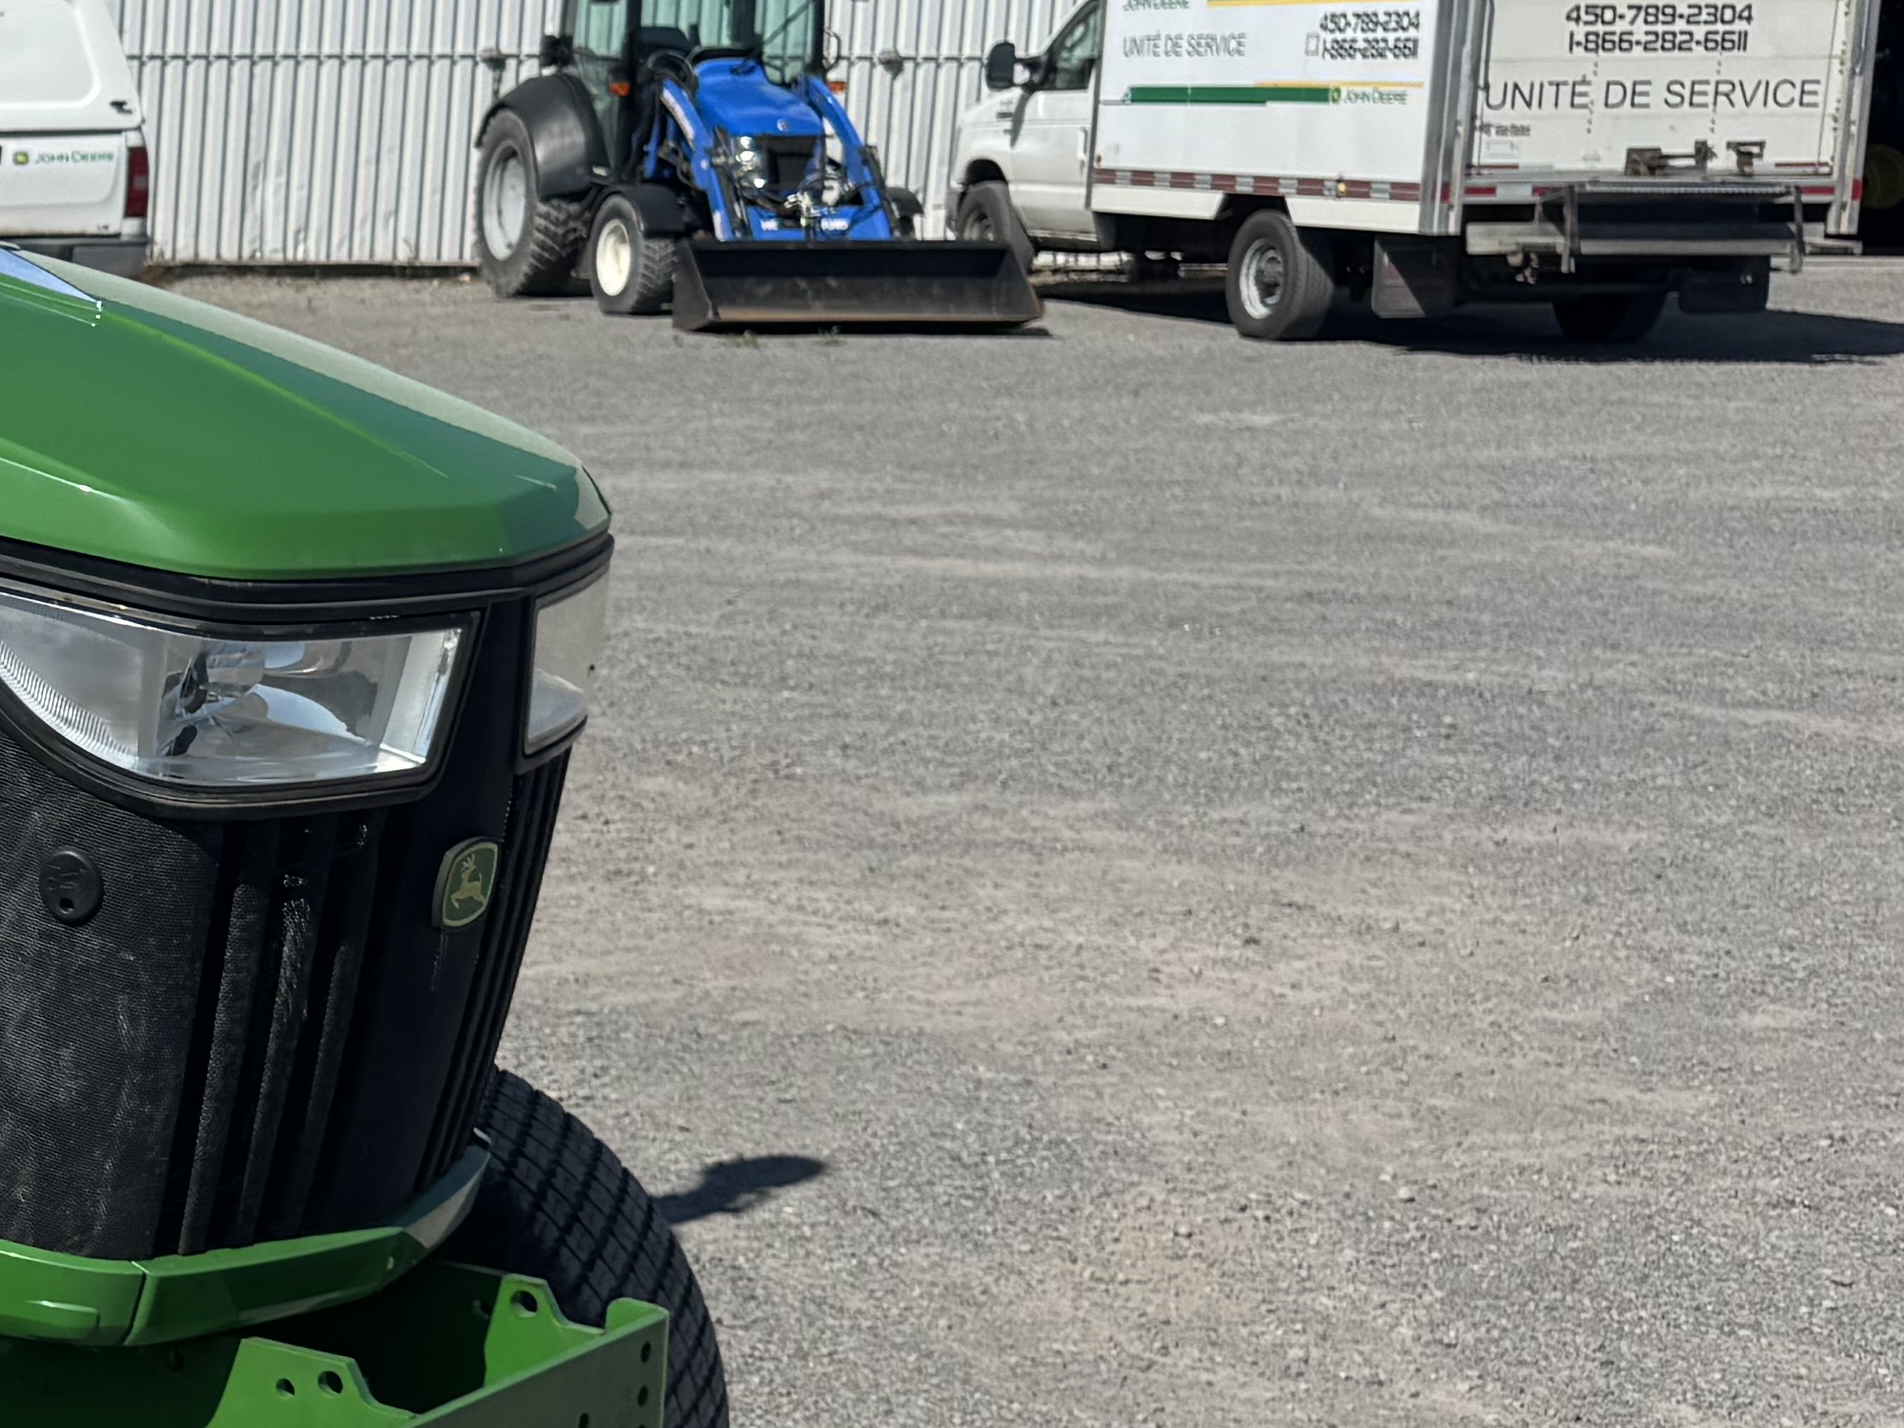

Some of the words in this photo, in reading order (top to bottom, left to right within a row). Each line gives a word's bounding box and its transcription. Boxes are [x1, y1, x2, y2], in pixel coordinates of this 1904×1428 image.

[1565, 3, 1754, 25] 450-789-2304
[1164, 33, 1183, 57] DE
[1186, 33, 1246, 57] SERVICE
[1568, 30, 1748, 52] 1-866-282-6611
[1485, 74, 1592, 110] UNITÉ
[1604, 80, 1652, 109] DE
[1663, 79, 1821, 109] SERVICE
